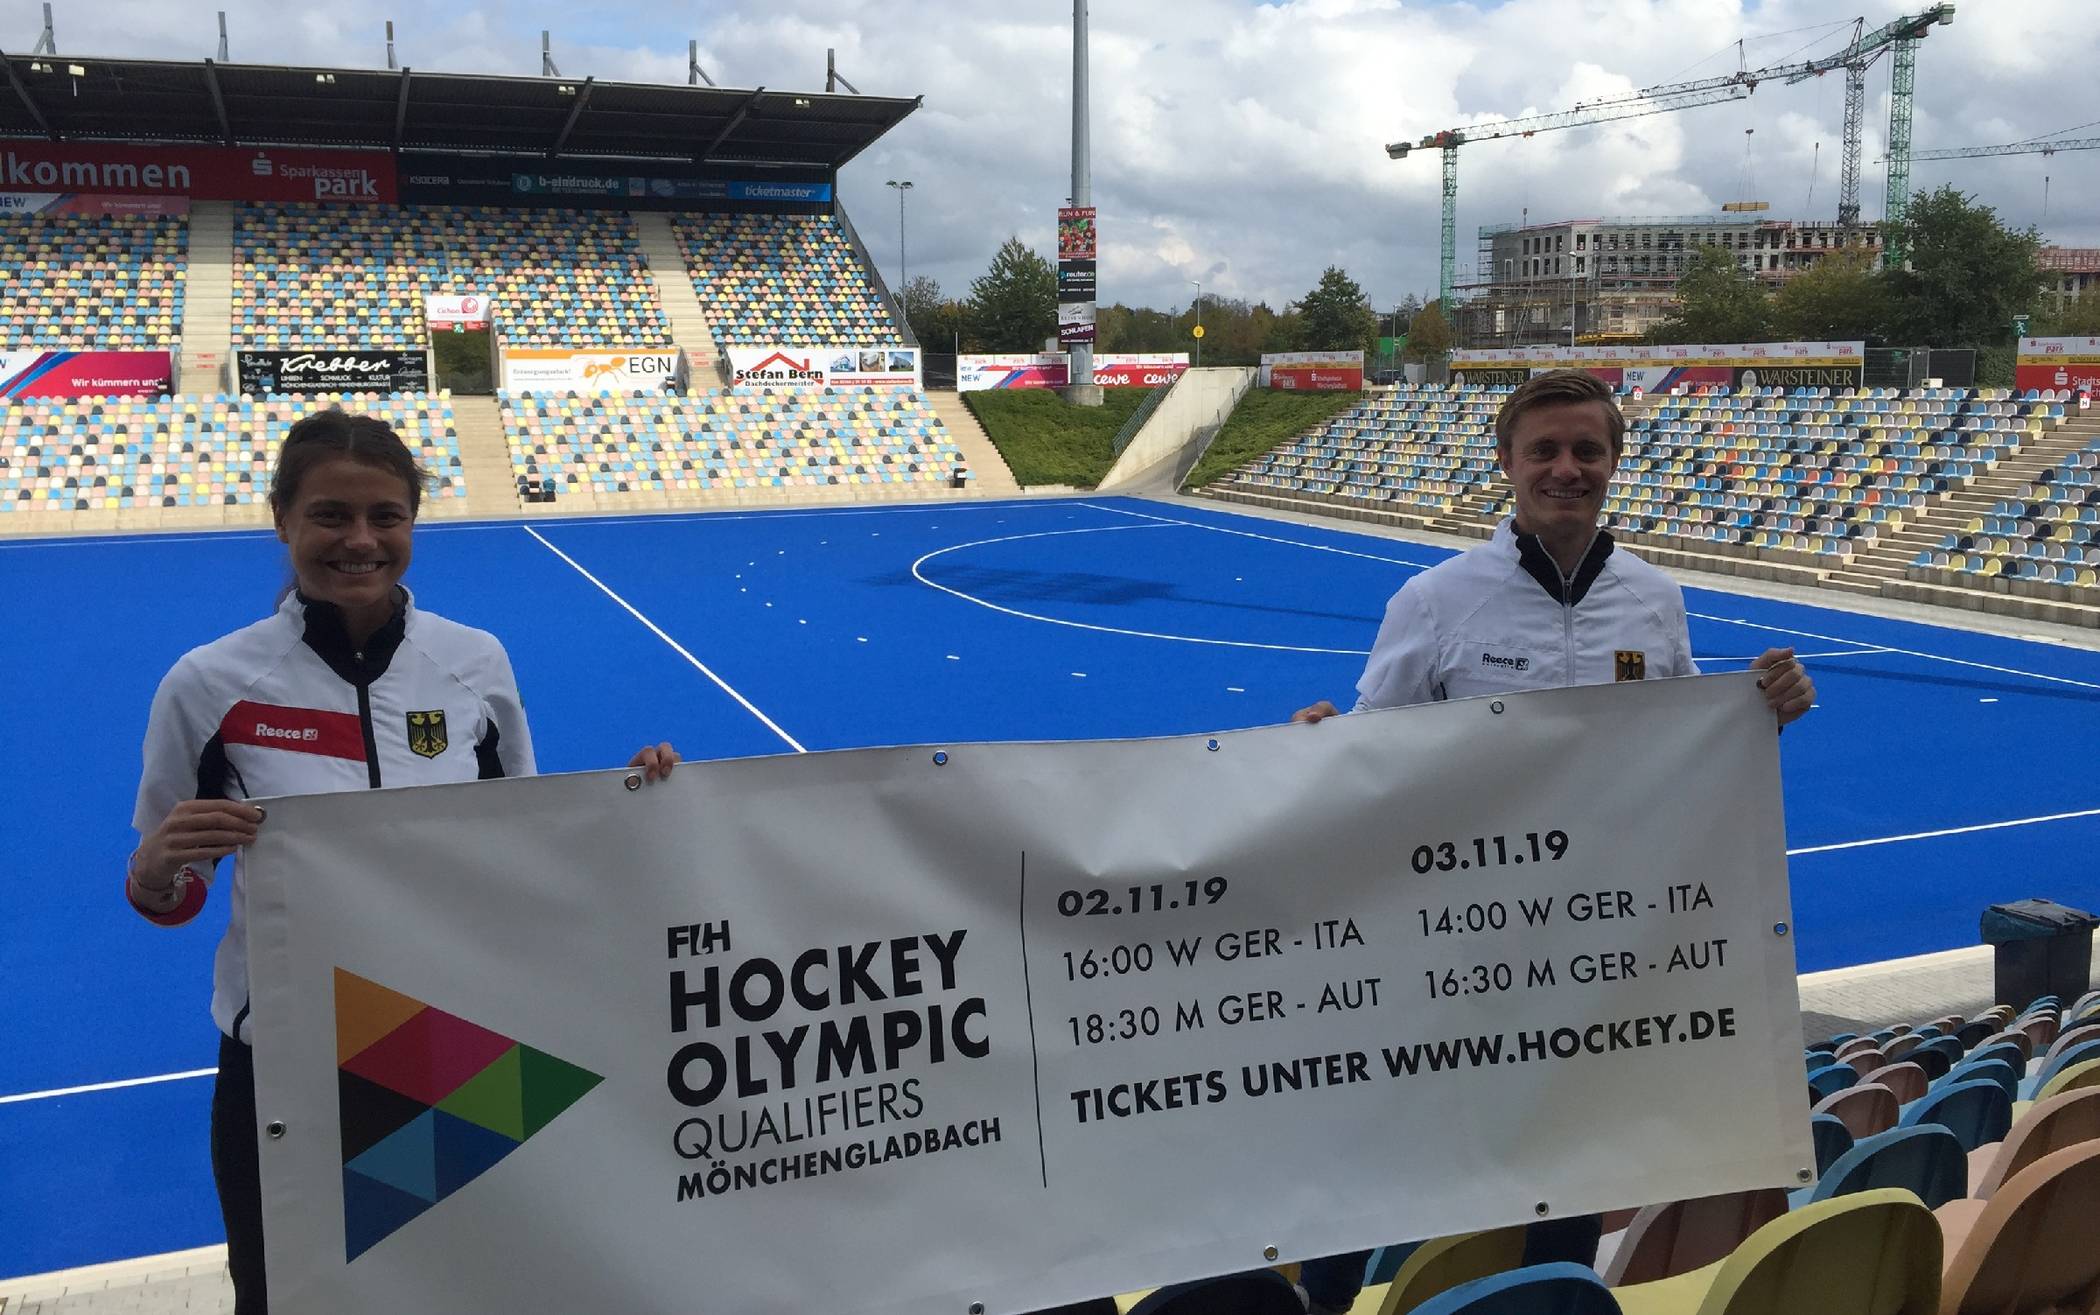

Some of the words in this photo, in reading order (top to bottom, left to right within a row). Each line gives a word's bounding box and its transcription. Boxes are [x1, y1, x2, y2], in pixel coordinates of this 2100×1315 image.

[280, 164, 360, 180] Sparkassen
[315, 169, 378, 199] park
[410, 176, 449, 185] KYOCERA
[745, 185, 811, 198] ticketmaster
[2046, 344, 2065, 353] park
[629, 357, 671, 373] EGN
[736, 369, 784, 380] Stefan
[788, 369, 824, 379] Bern
[1466, 370, 1525, 384] WARSTEINER
[1626, 371, 1645, 381] NEW
[72, 378, 90, 387] Wir
[92, 377, 140, 387] kümmern
[1759, 369, 1853, 386] WARSTEINER
[1481, 652, 1514, 666] Reece
[256, 722, 302, 740] Reece
[1411, 830, 1569, 874] 03.11.19
[1057, 876, 1228, 917] 02.11.19
[1418, 902, 1507, 936] 14:00
[1518, 897, 1553, 927] W
[1567, 890, 1637, 922] GER
[1668, 882, 1714, 914] ITA
[1063, 943, 1154, 981] 16:00
[1165, 936, 1202, 967] W
[1215, 928, 1283, 961] GER
[1314, 917, 1365, 949] ITA
[1425, 962, 1513, 998] 16:30
[1527, 957, 1556, 988] M
[1570, 951, 1638, 983] GER
[1666, 939, 1728, 973] AUT
[668, 929, 968, 1034] HOCKEY
[1068, 1005, 1160, 1046] 18:30
[1175, 999, 1205, 1032] M
[1218, 990, 1287, 1025] GER
[1317, 977, 1381, 1013] AUT
[667, 997, 990, 1107] OLYMPIC
[1071, 1070, 1228, 1123] TICKETS
[1241, 1051, 1372, 1097] UNTER
[1381, 1007, 1736, 1078] WWW.HOCKEY.DE
[673, 1078, 924, 1160] QUALIFIERS
[677, 1117, 1002, 1202] MÖNCHENGLADBACH
